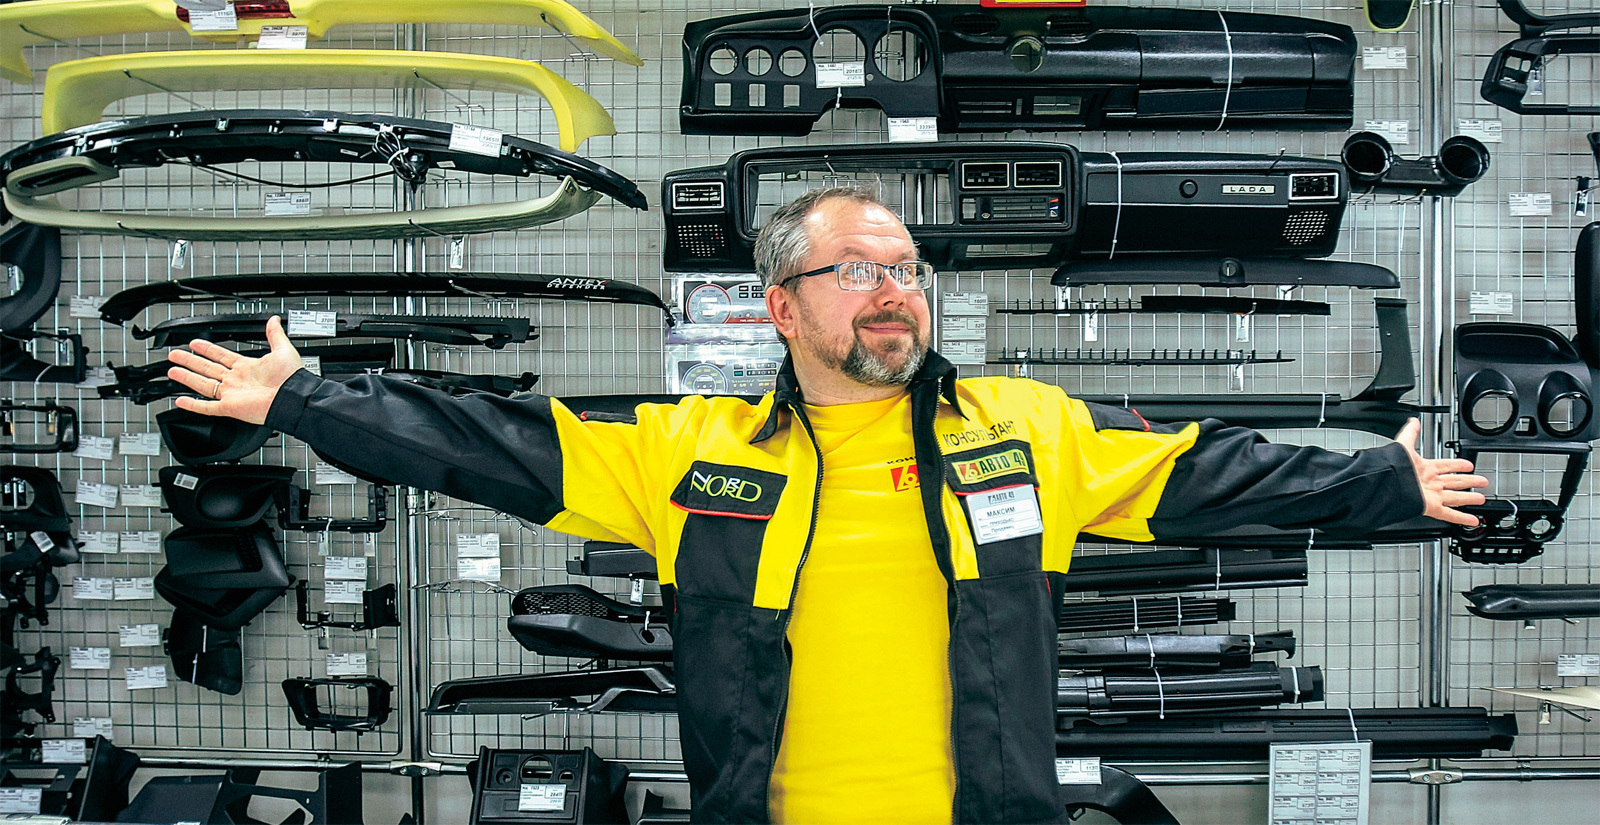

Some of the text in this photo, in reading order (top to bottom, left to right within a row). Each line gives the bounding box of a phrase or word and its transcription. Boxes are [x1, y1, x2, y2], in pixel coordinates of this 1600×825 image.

[547, 278, 606, 286] ANTEY
[943, 420, 1017, 447] КОНСУЛЬТАНТ
[979, 455, 1010, 474] АВТО
[690, 470, 762, 503] NORD
[986, 506, 1016, 517] МАКСИМ
